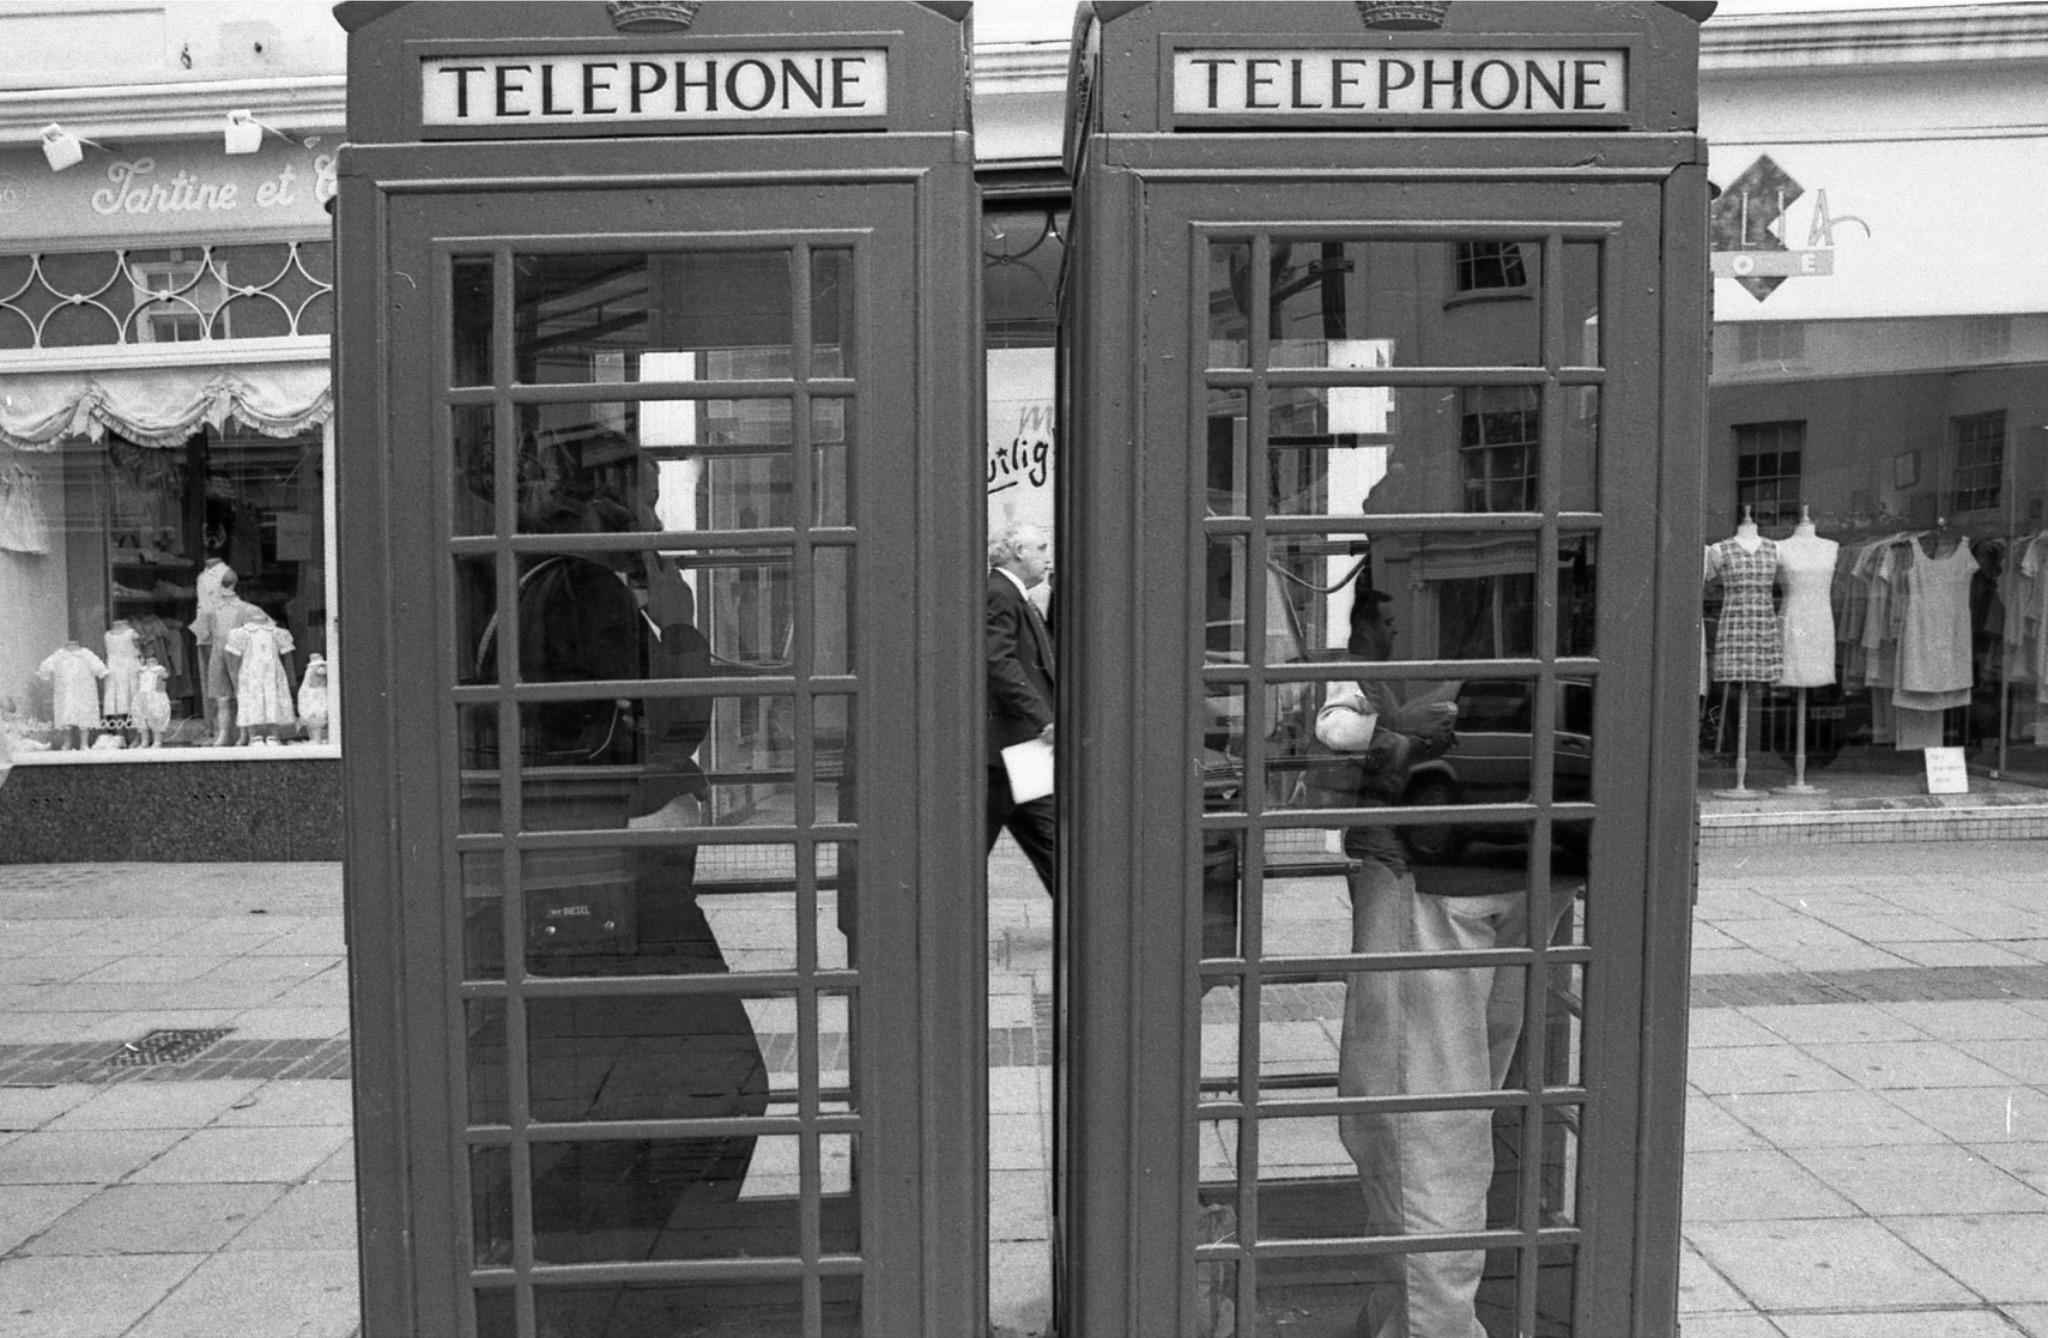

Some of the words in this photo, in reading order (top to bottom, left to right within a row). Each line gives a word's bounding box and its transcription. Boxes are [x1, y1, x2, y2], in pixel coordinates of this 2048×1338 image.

[438, 57, 867, 117] TELEPHONE
[1190, 59, 1607, 110] TELEPHONE
[91, 157, 238, 215] Tartine
[255, 165, 297, 207] et
[562, 905, 590, 916] DIESEL
